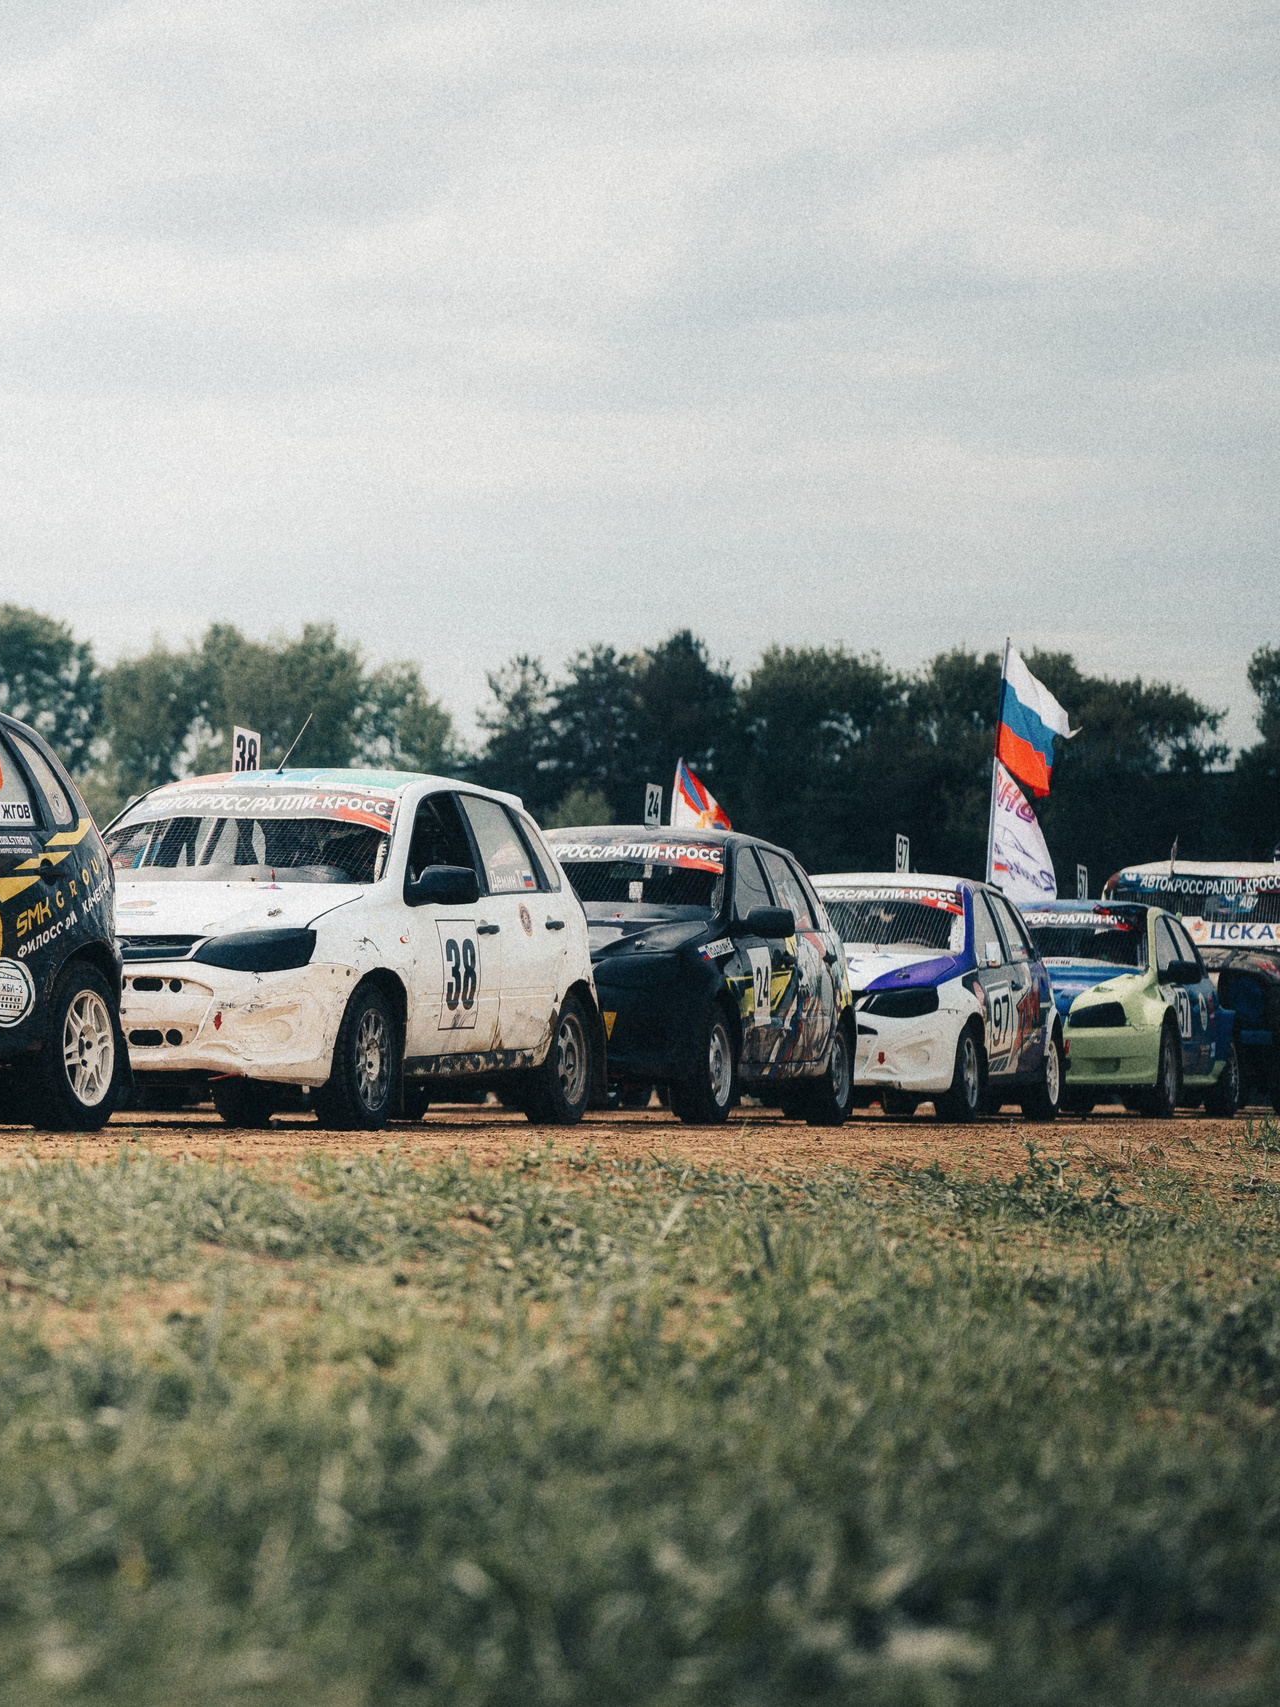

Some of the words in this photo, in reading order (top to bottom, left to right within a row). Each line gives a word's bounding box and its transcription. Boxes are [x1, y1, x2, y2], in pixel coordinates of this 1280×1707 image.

[236, 735, 257, 771] 38
[147, 794, 388, 815] АВТОКРОСС/РАЛЛИ-КРОСС
[647, 790, 659, 818] 24
[898, 837, 908, 869] 97
[1140, 875, 1280, 895] АВТОКРОСС/РАЛЛИ-КРОСС
[16, 896, 52, 938] SMK
[1210, 924, 1274, 940] ЦСКА
[1, 983, 23, 993] ЖБИ-2
[446, 938, 477, 1010] 38
[756, 966, 769, 1007] 24
[992, 994, 1010, 1047] 97
